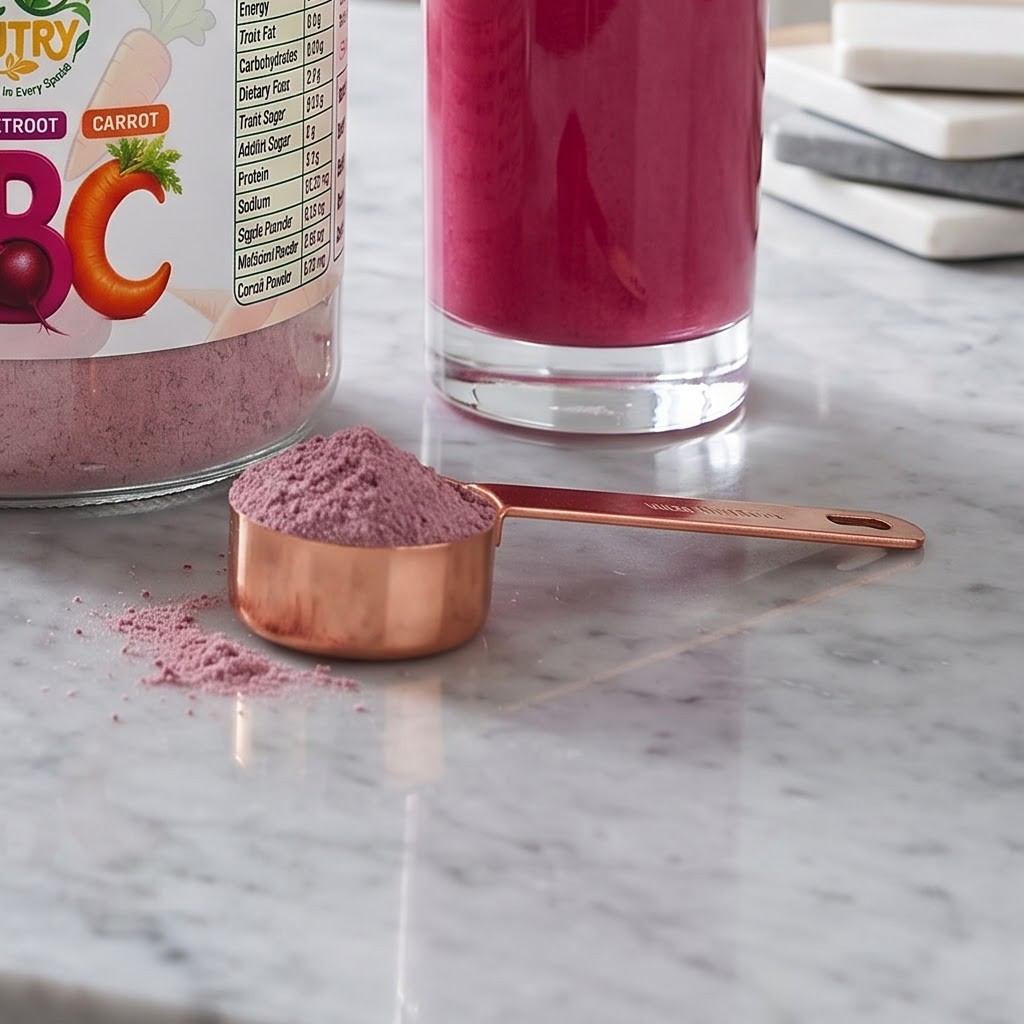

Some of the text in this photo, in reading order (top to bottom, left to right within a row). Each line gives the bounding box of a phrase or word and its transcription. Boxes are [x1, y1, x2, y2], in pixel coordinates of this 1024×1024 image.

[240, 1, 269, 17] Energy
[263, 25, 276, 40] Fat
[16, 85, 42, 97] Every
[239, 84, 270, 102] Dietary
[93, 112, 159, 131] CARROT
[239, 167, 268, 186] Protein
